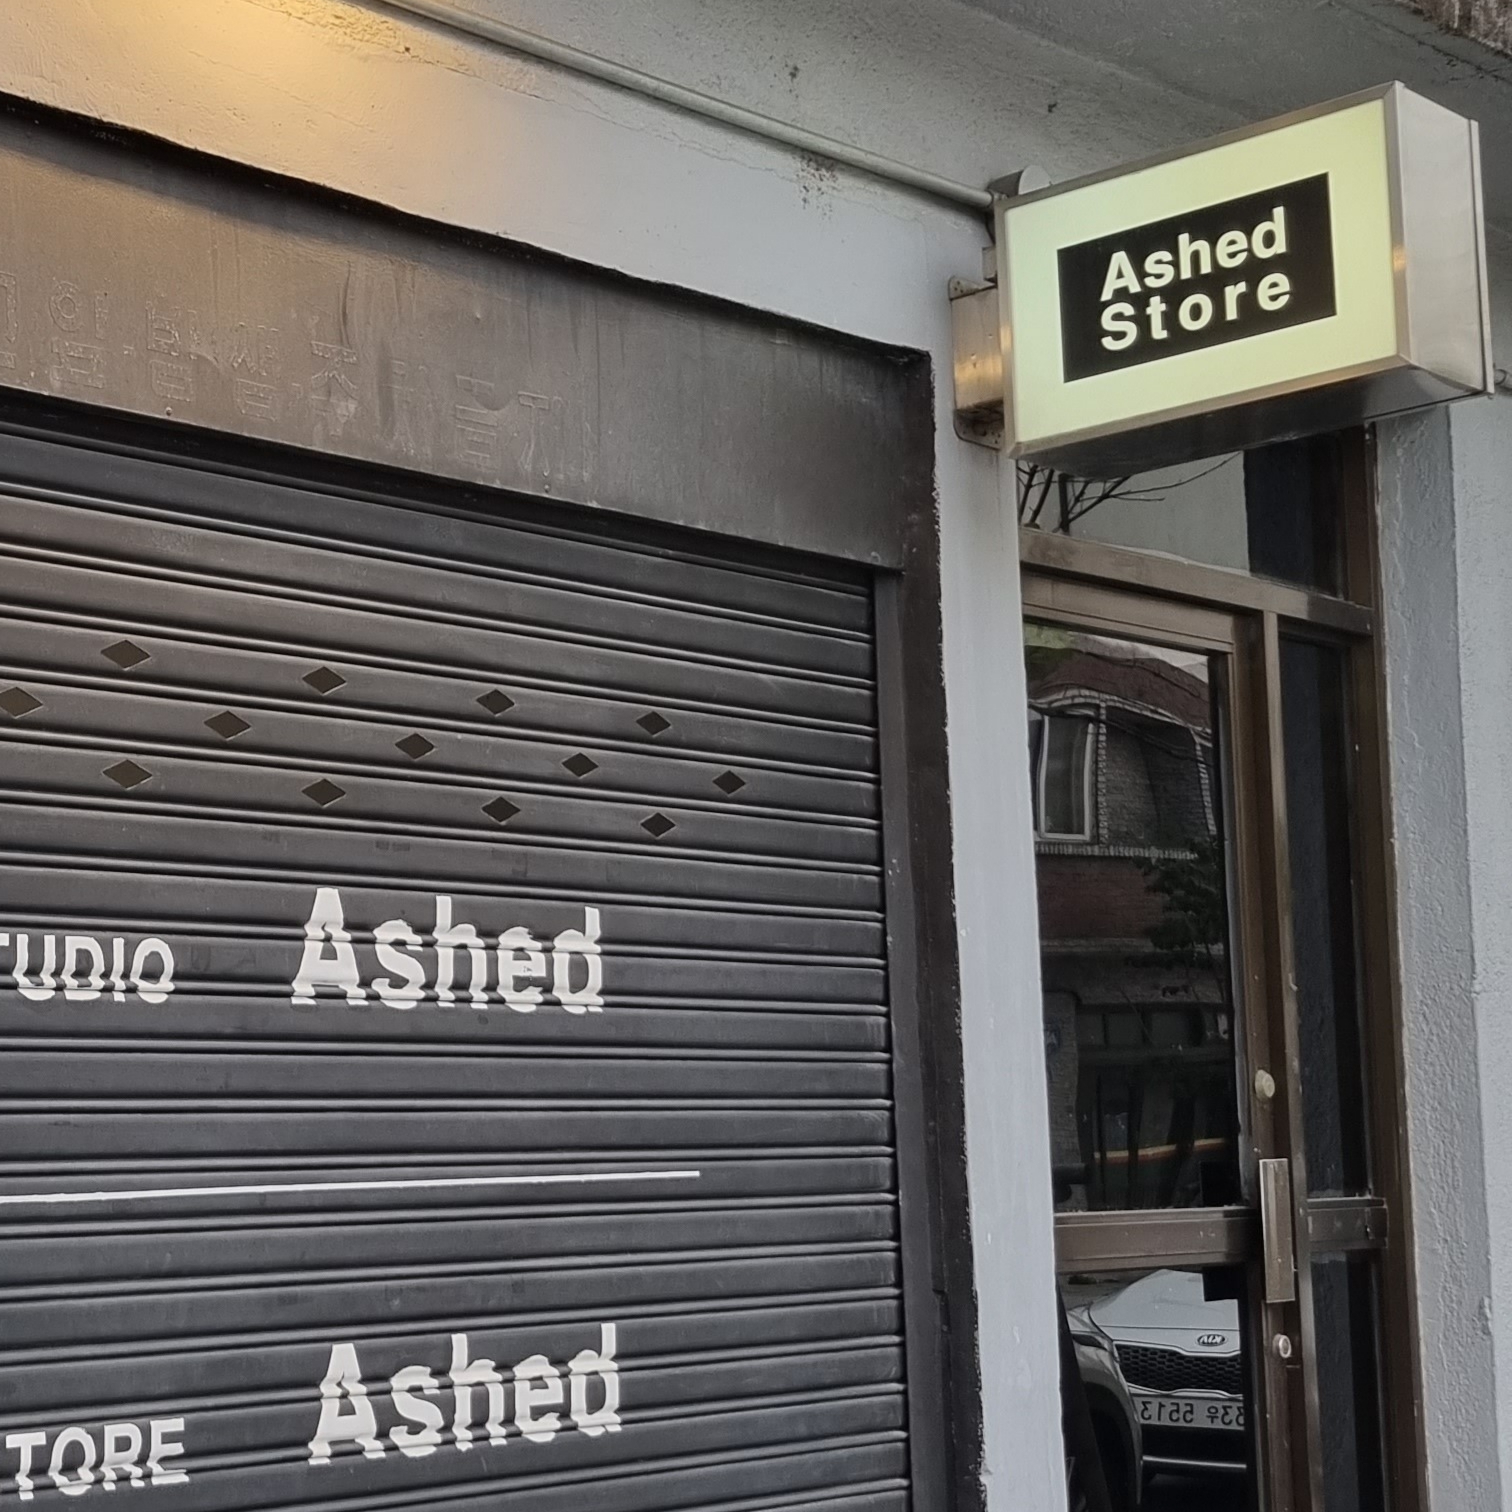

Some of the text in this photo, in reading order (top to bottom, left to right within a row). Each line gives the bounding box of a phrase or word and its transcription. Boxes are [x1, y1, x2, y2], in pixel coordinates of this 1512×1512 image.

[1100, 205, 1287, 301] Ashed
[1100, 271, 1290, 351] Store
[291, 886, 605, 1014] Ashed
[308, 1323, 622, 1465] Ashed
